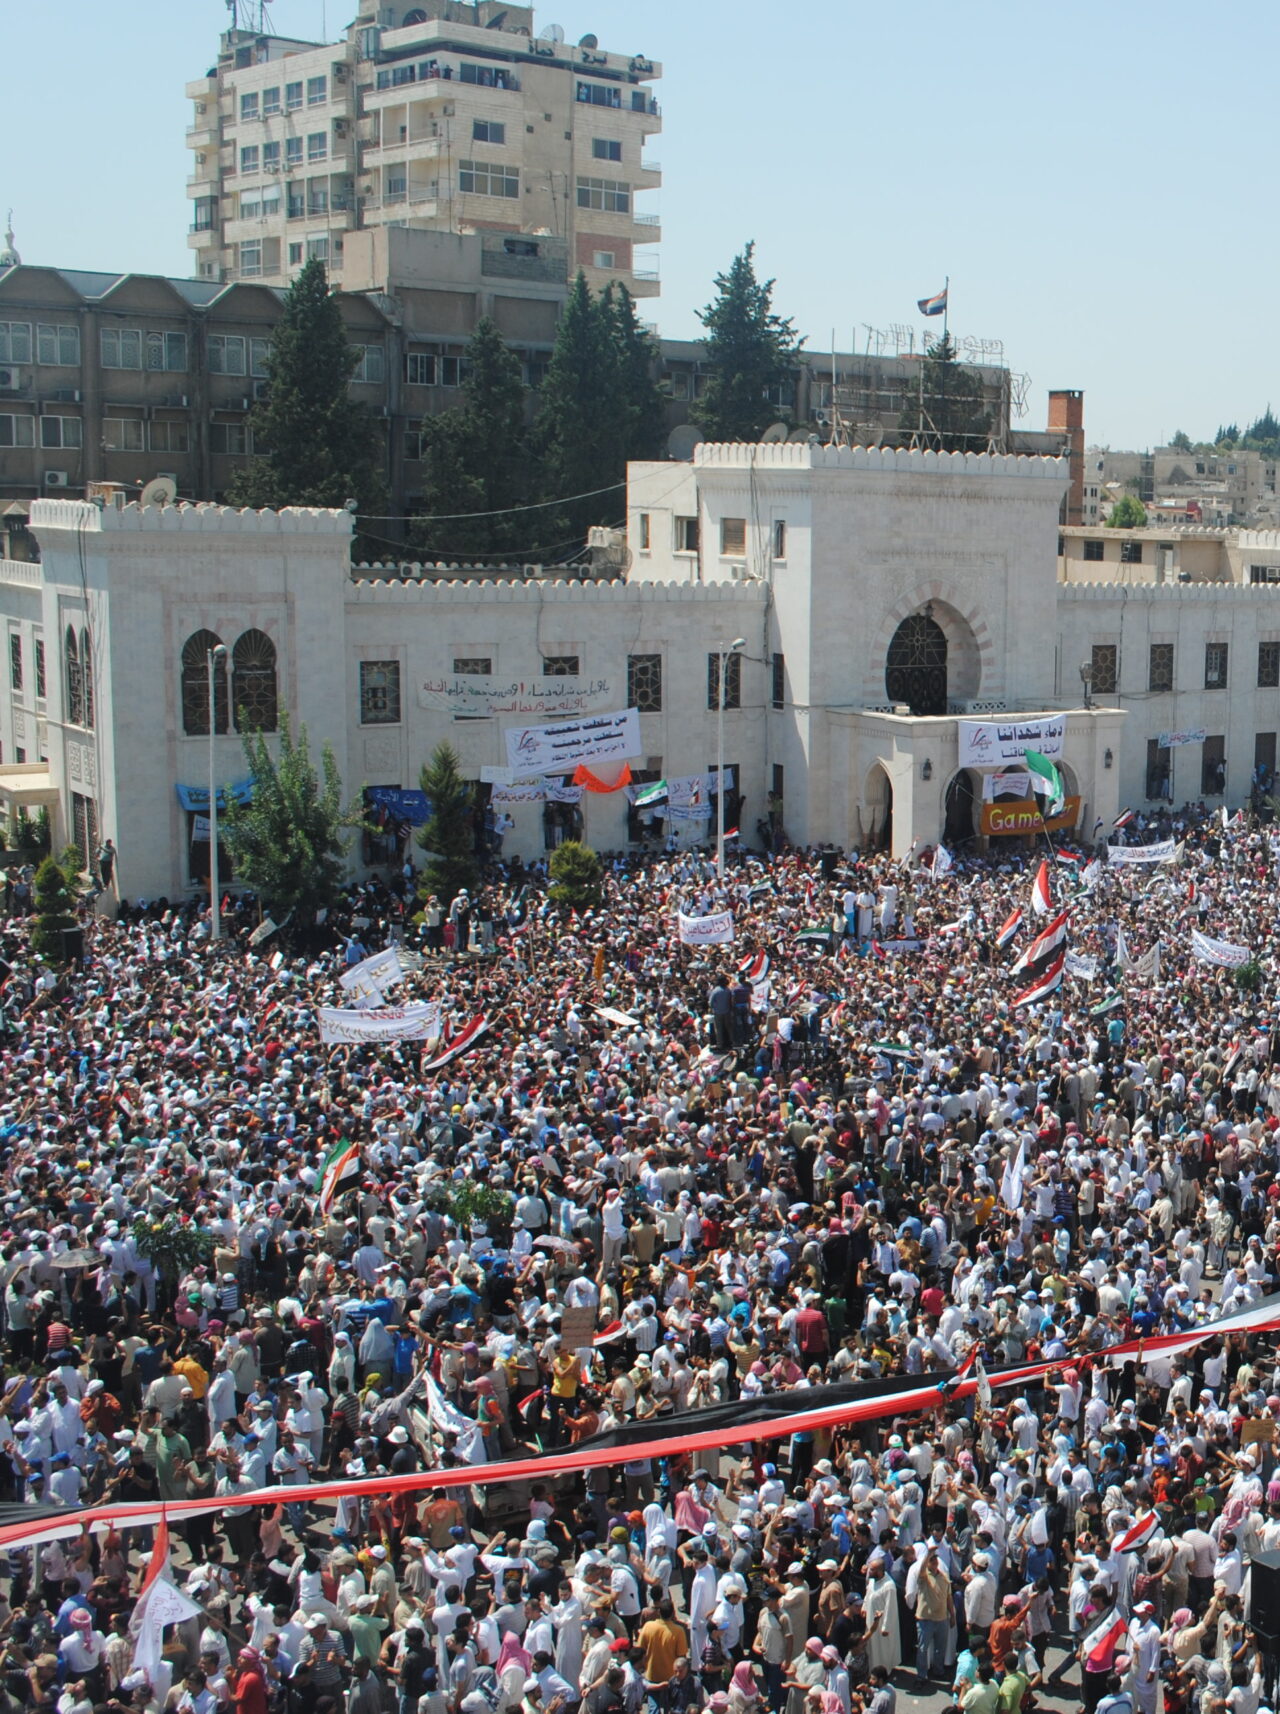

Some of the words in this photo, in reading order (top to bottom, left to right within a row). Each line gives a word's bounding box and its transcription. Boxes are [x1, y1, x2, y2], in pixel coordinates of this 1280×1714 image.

[528, 38, 554, 57] حماة
[581, 49, 608, 66] برج
[629, 57, 653, 73] فندق
[615, 717, 627, 726] من
[544, 722, 581, 738] شعبيته
[997, 725, 1042, 741] شهدائنا
[1044, 724, 1063, 739] دماء
[990, 808, 1042, 831] Game
